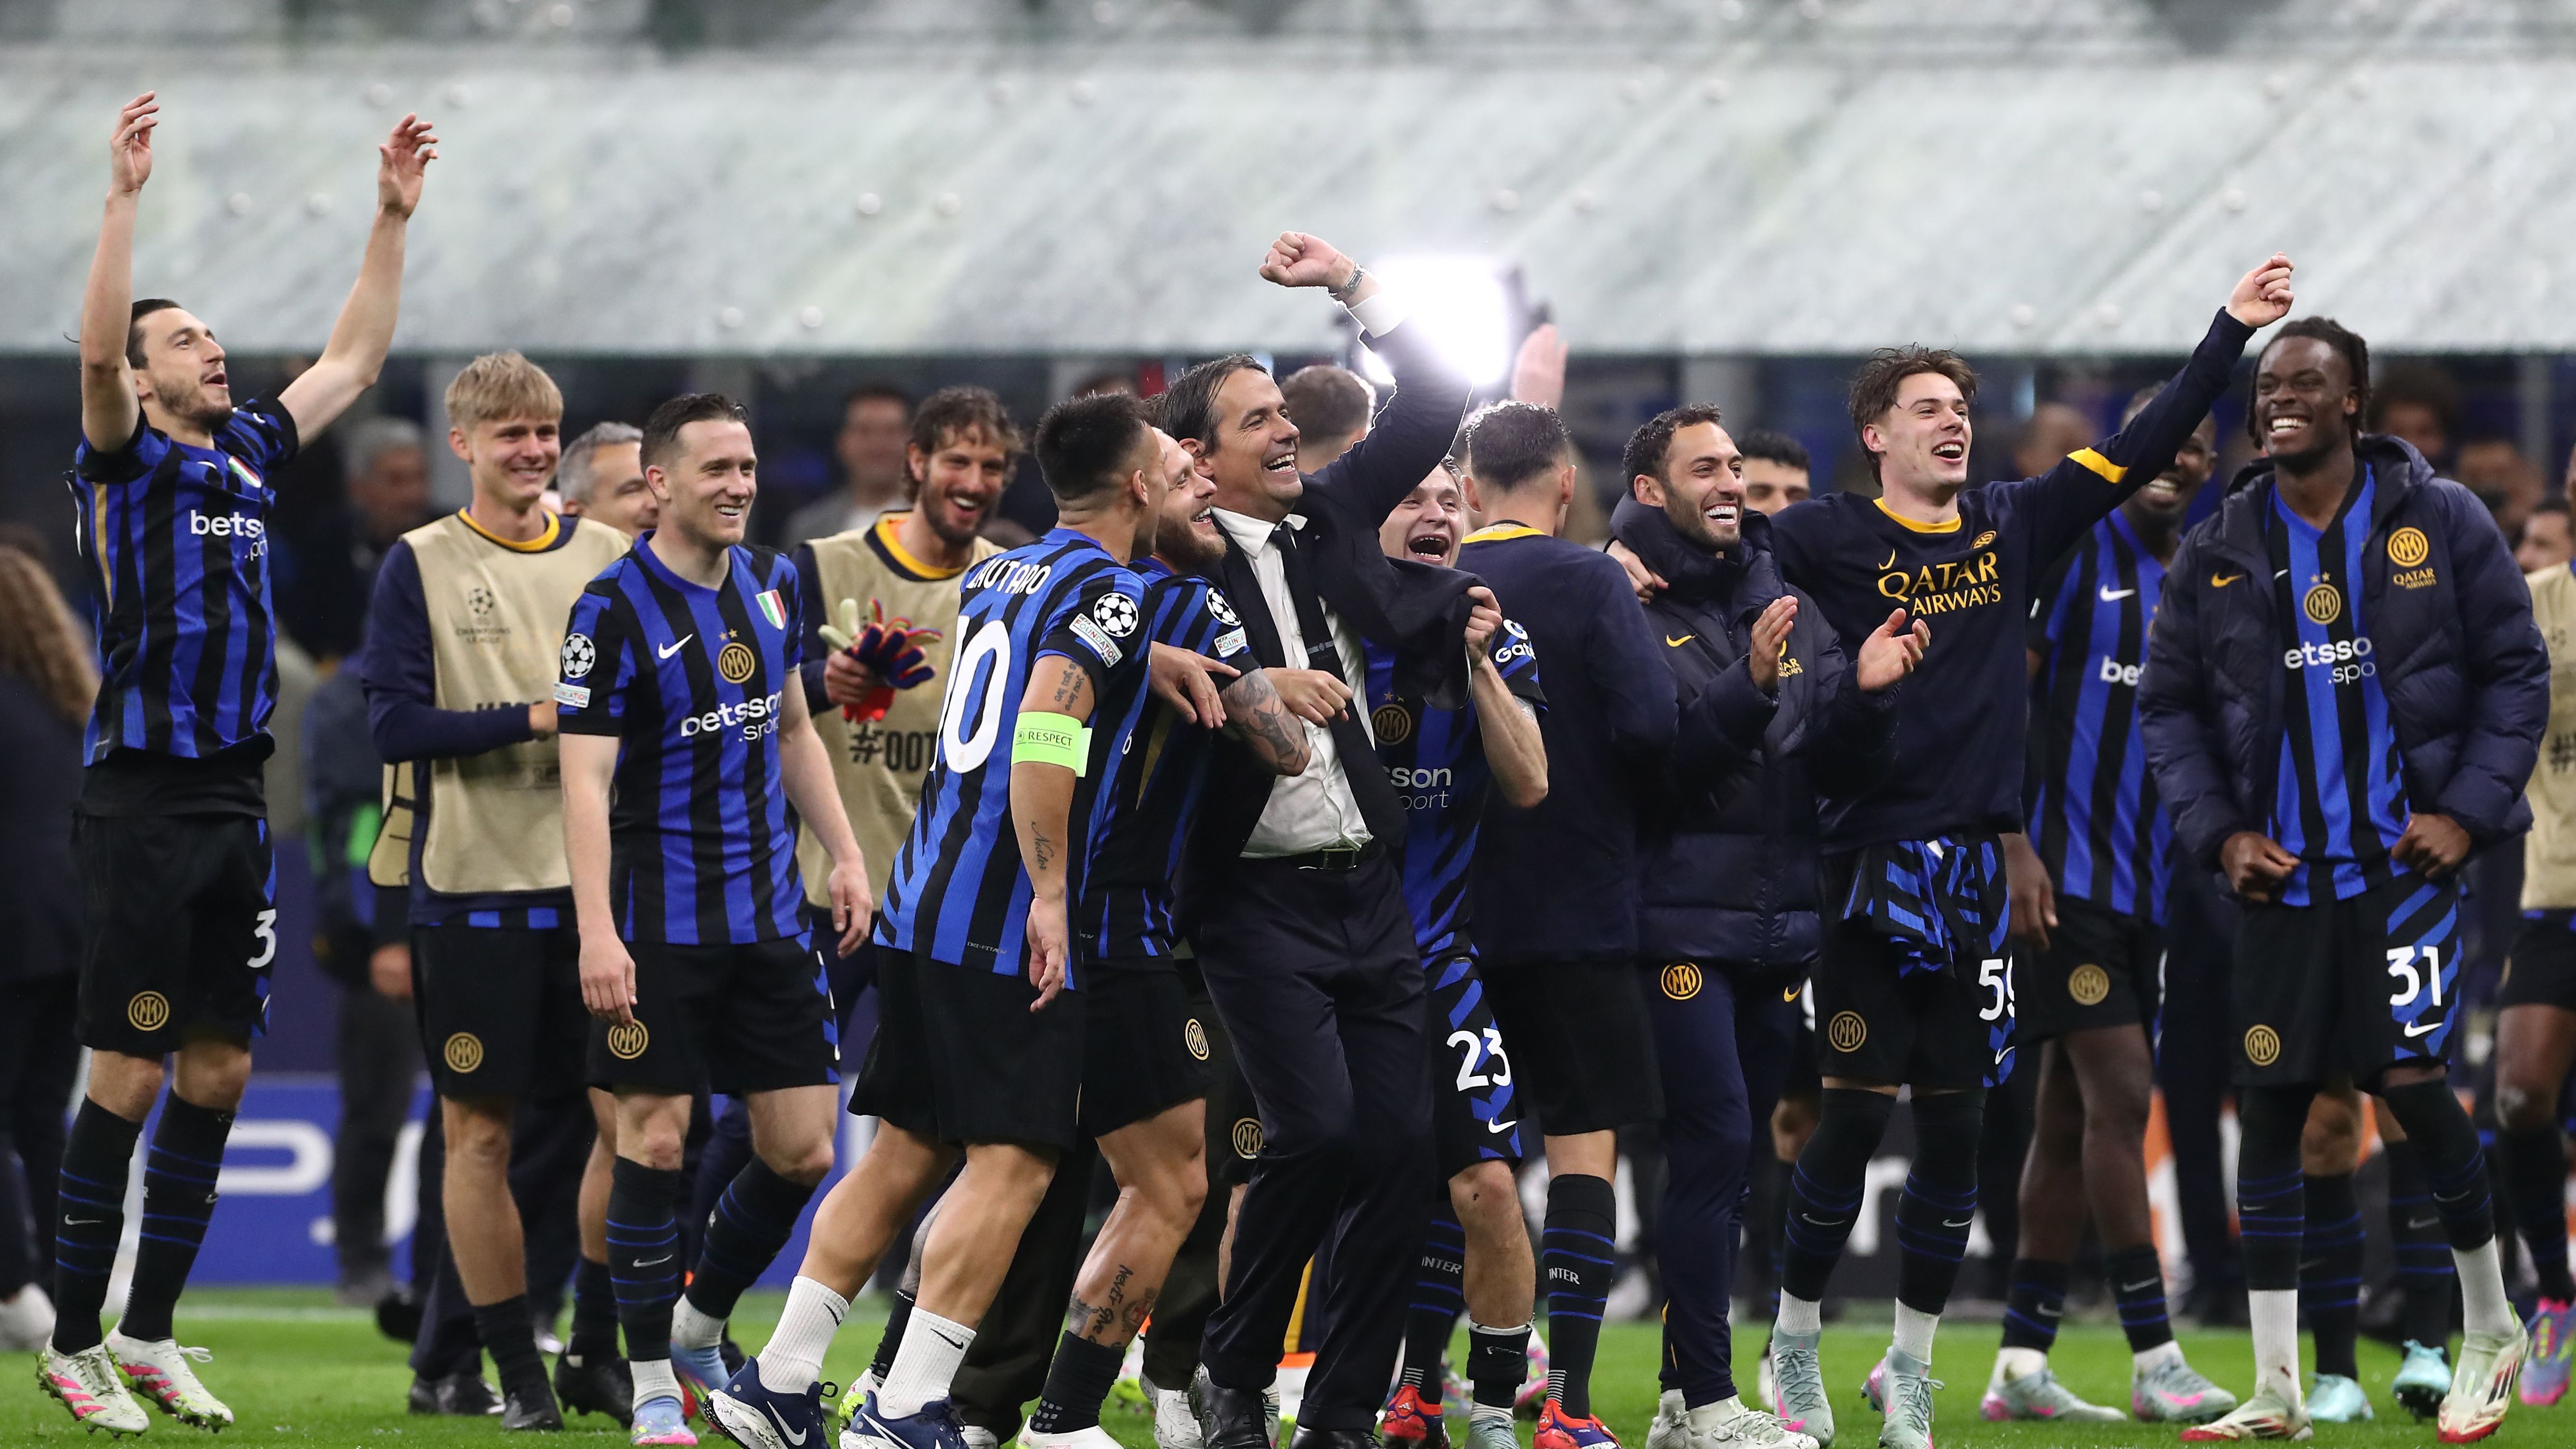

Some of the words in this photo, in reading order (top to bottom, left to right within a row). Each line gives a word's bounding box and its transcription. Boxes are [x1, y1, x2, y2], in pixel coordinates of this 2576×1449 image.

[190, 509, 264, 538] bets
[965, 558, 1051, 595] LAUTARO
[1878, 552, 1999, 603] QATAR
[2393, 568, 2435, 586] QATAR
[1912, 584, 2001, 616] AIRWAYS
[1075, 619, 1118, 663] FOUNDATION
[2284, 637, 2372, 670] etsso
[2100, 655, 2146, 686] be
[2327, 662, 2375, 685] .spo
[1028, 731, 1072, 746] RESPECT
[1382, 766, 1451, 788] son
[2387, 946, 2441, 1006] 31
[1447, 1028, 1511, 1092] 23
[1422, 1257, 1462, 1274] INTER
[1549, 1267, 1580, 1284] INTER
